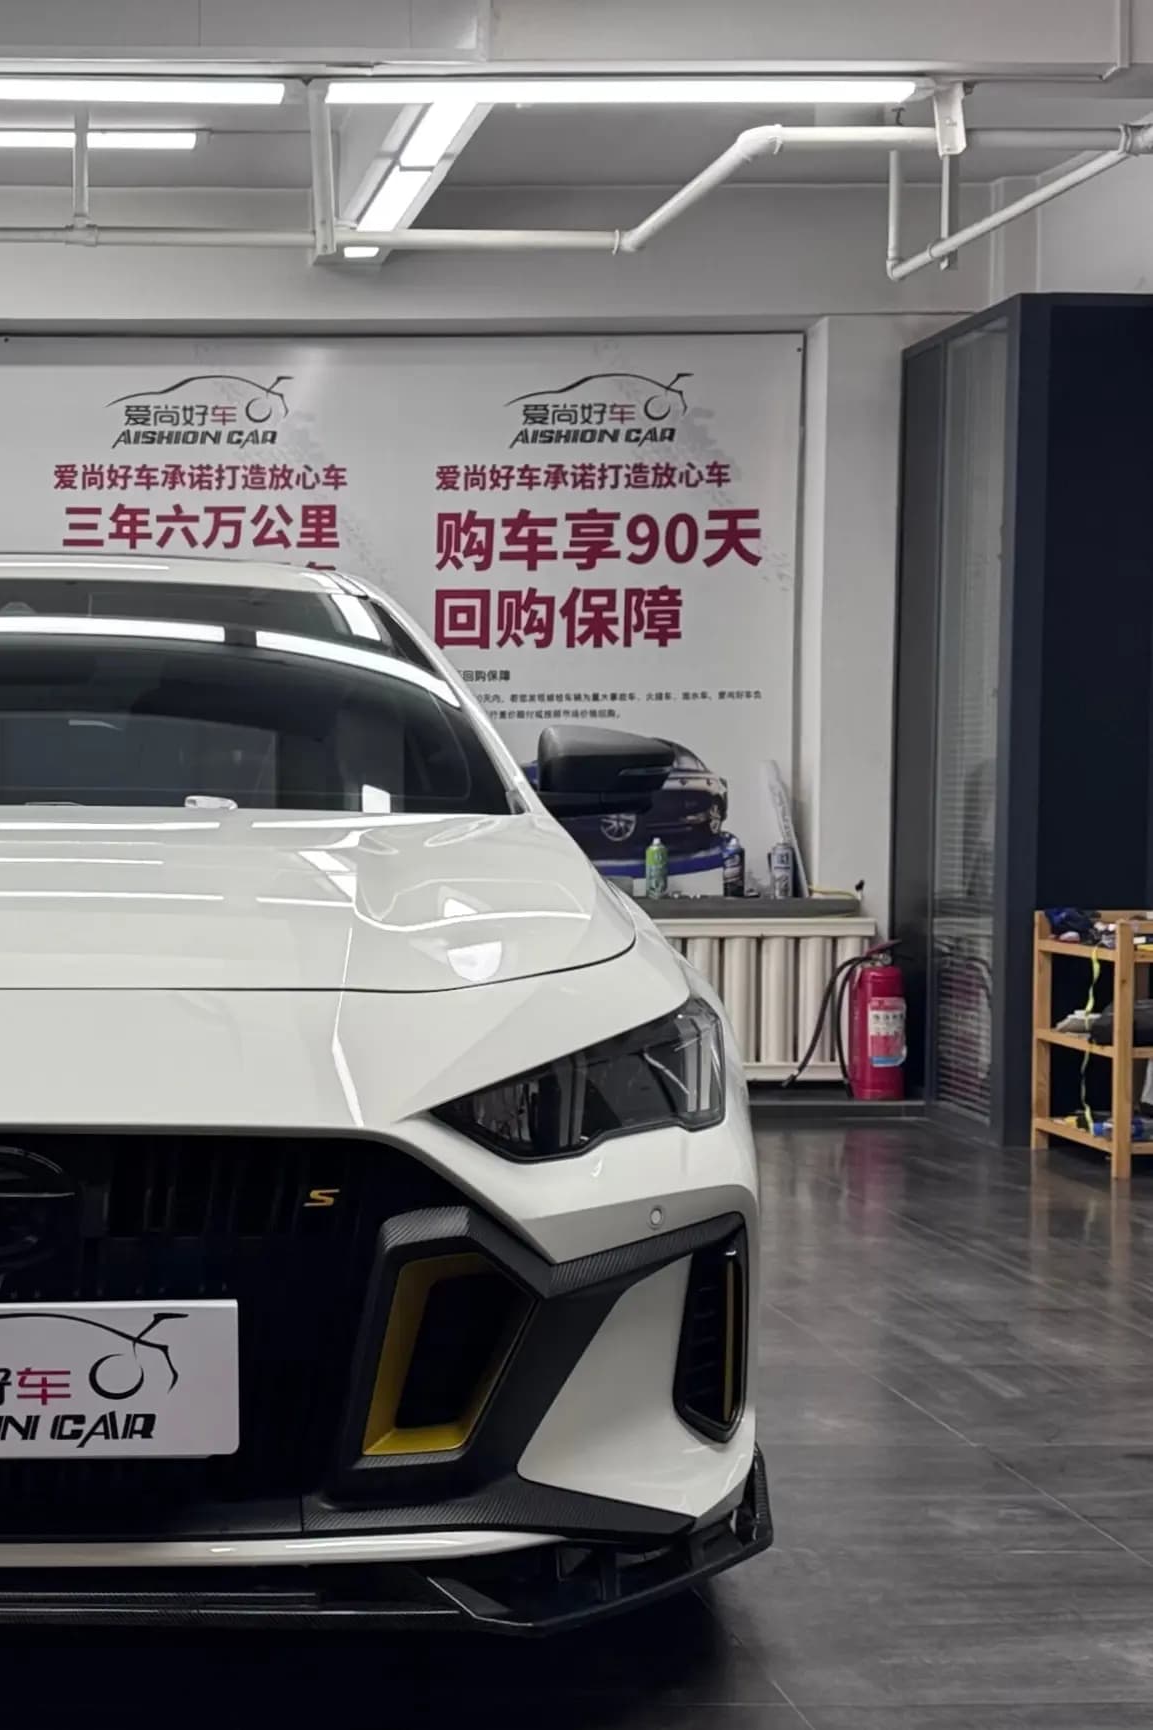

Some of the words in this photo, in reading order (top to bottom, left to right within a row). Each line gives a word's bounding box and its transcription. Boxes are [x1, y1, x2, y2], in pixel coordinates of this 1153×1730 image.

[124, 404, 237, 426] 爱尚好车
[522, 402, 636, 425] 爱尚好车
[111, 429, 222, 449] AISHION
[226, 429, 278, 449] CAR
[509, 428, 620, 448] AISHION
[625, 427, 677, 447] CAR
[53, 463, 348, 491] 爱尚好车承诺打造放心车
[435, 460, 732, 491] 爱尚好车承诺打造放心车
[62, 503, 341, 550] 三年六万公里
[435, 507, 763, 572] 购车享90天
[434, 585, 683, 650] 回购保障
[303, 1188, 340, 1207] S
[49, 1410, 157, 1449] CAR
